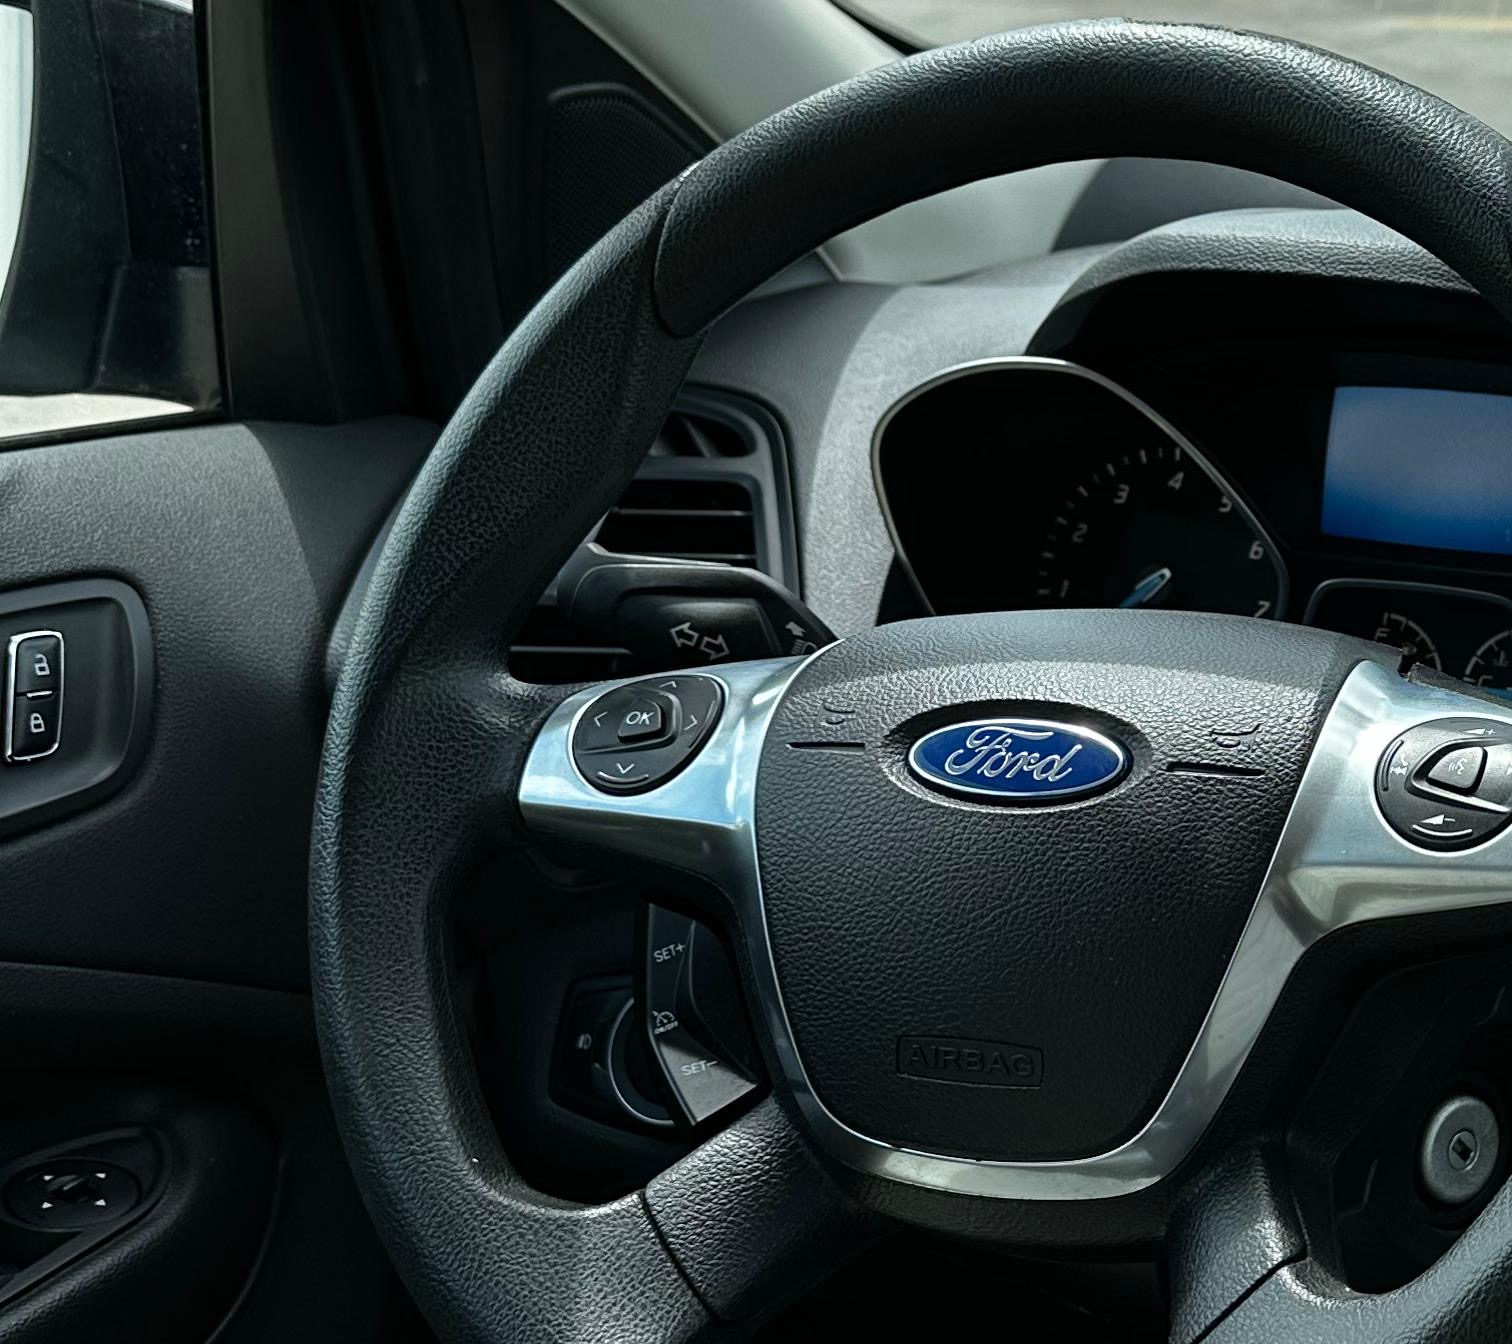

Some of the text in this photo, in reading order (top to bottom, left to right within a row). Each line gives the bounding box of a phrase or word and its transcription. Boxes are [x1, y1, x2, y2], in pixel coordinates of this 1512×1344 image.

[1167, 471, 1184, 491] 4
[1112, 484, 1131, 505] 3
[1072, 523, 1089, 544] 2
[1248, 540, 1265, 560] 6
[626, 711, 655, 725] OK
[944, 726, 1083, 783] Ford
[907, 1043, 1034, 1077] AIRBAG
